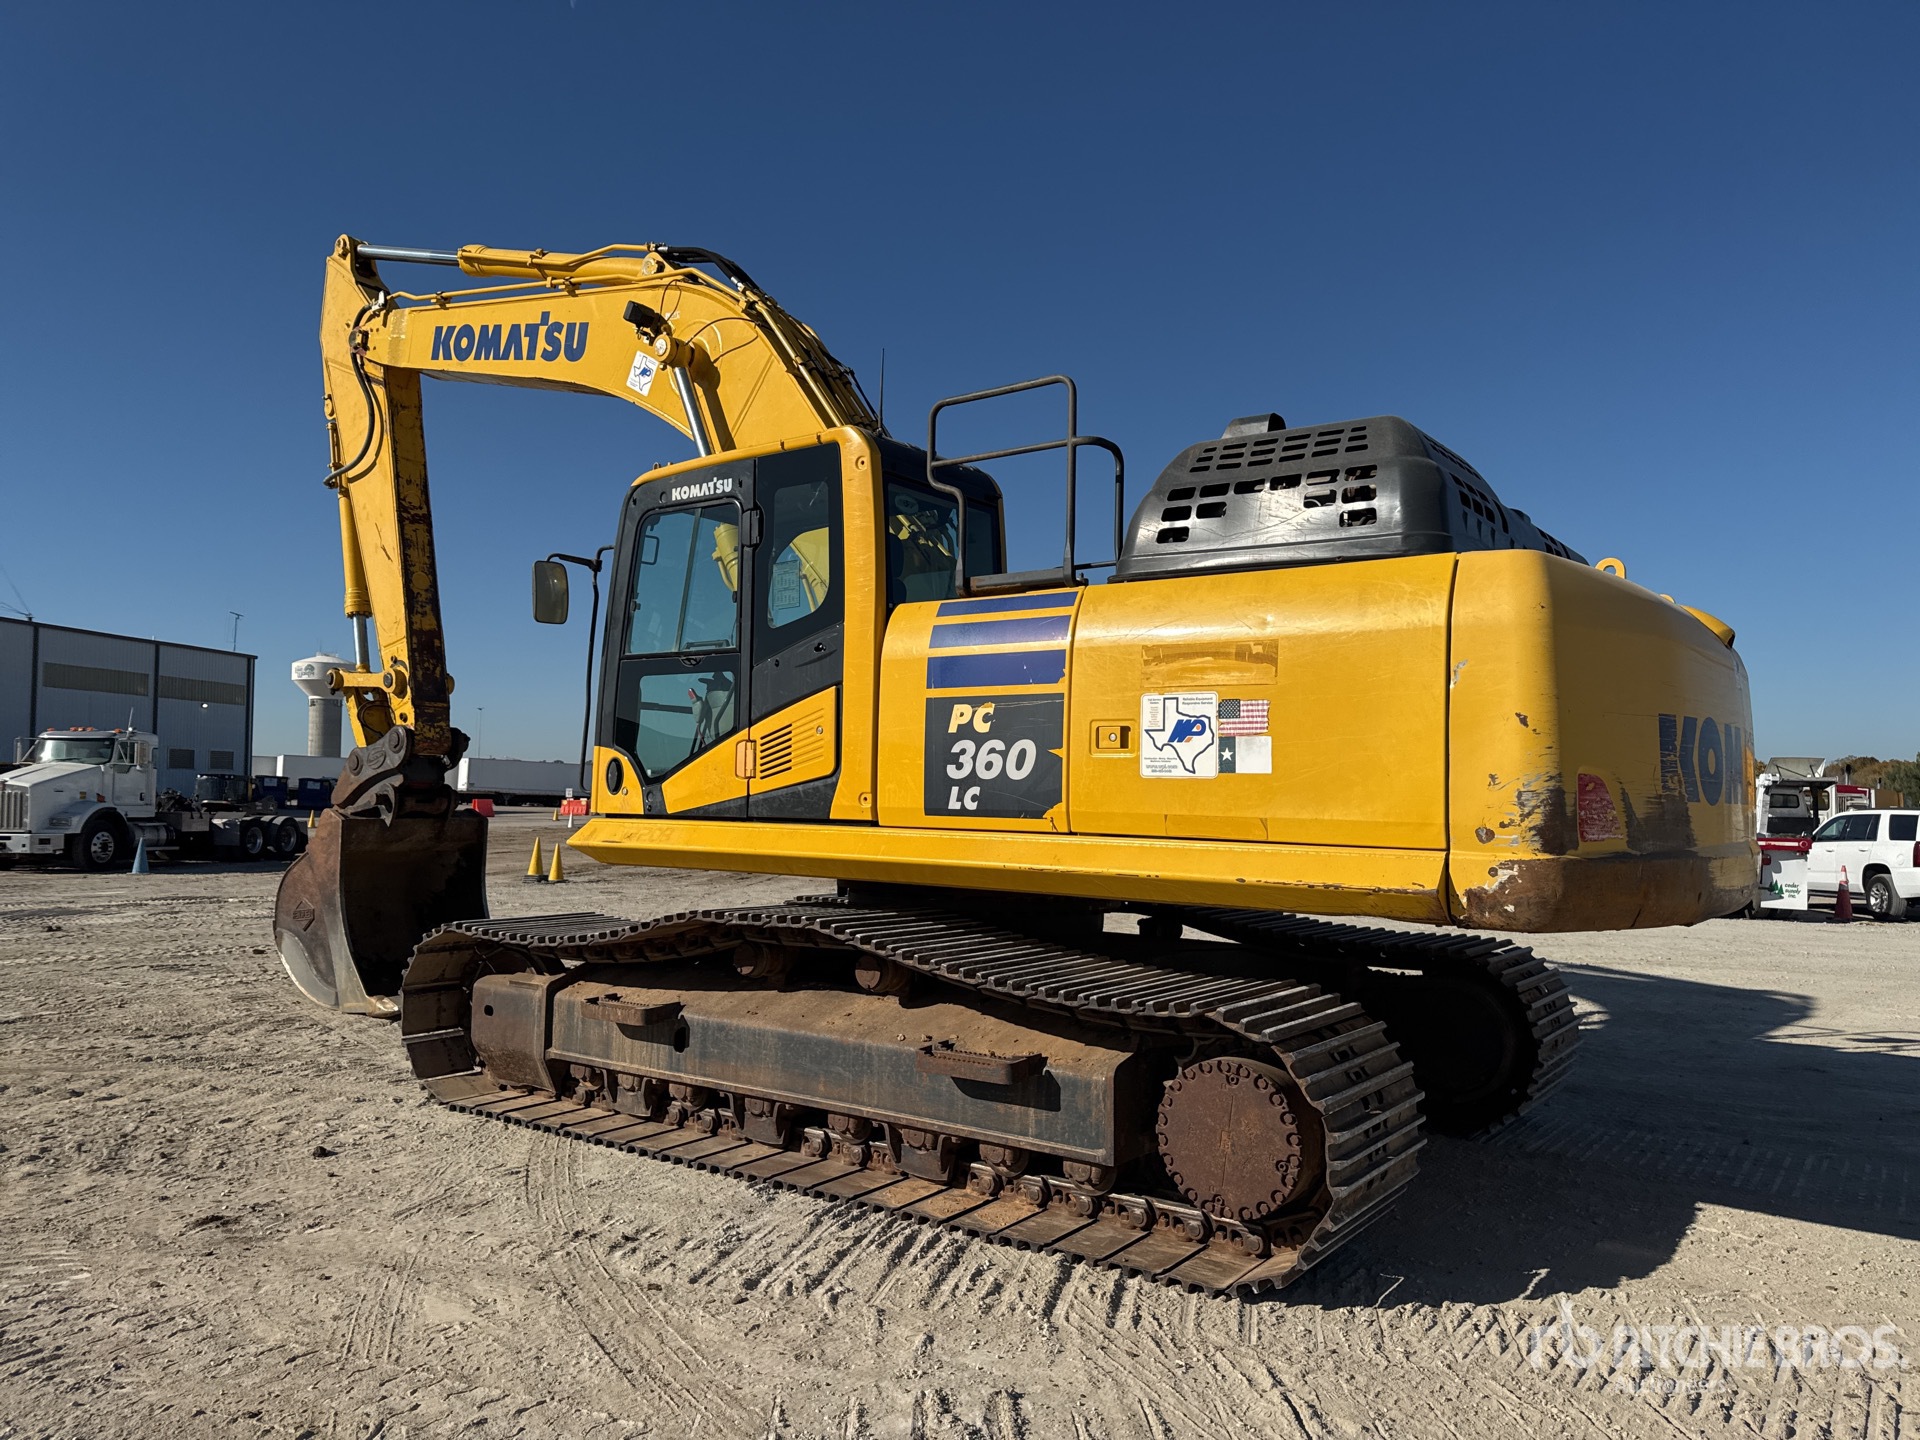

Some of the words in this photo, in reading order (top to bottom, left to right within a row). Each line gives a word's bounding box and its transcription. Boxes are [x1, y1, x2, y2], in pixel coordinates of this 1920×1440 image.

[430, 310, 590, 363] KOMATSU
[671, 476, 733, 502] KOMATSU
[947, 702, 996, 734] PC
[946, 738, 1037, 781] 360
[947, 785, 981, 811] LC
